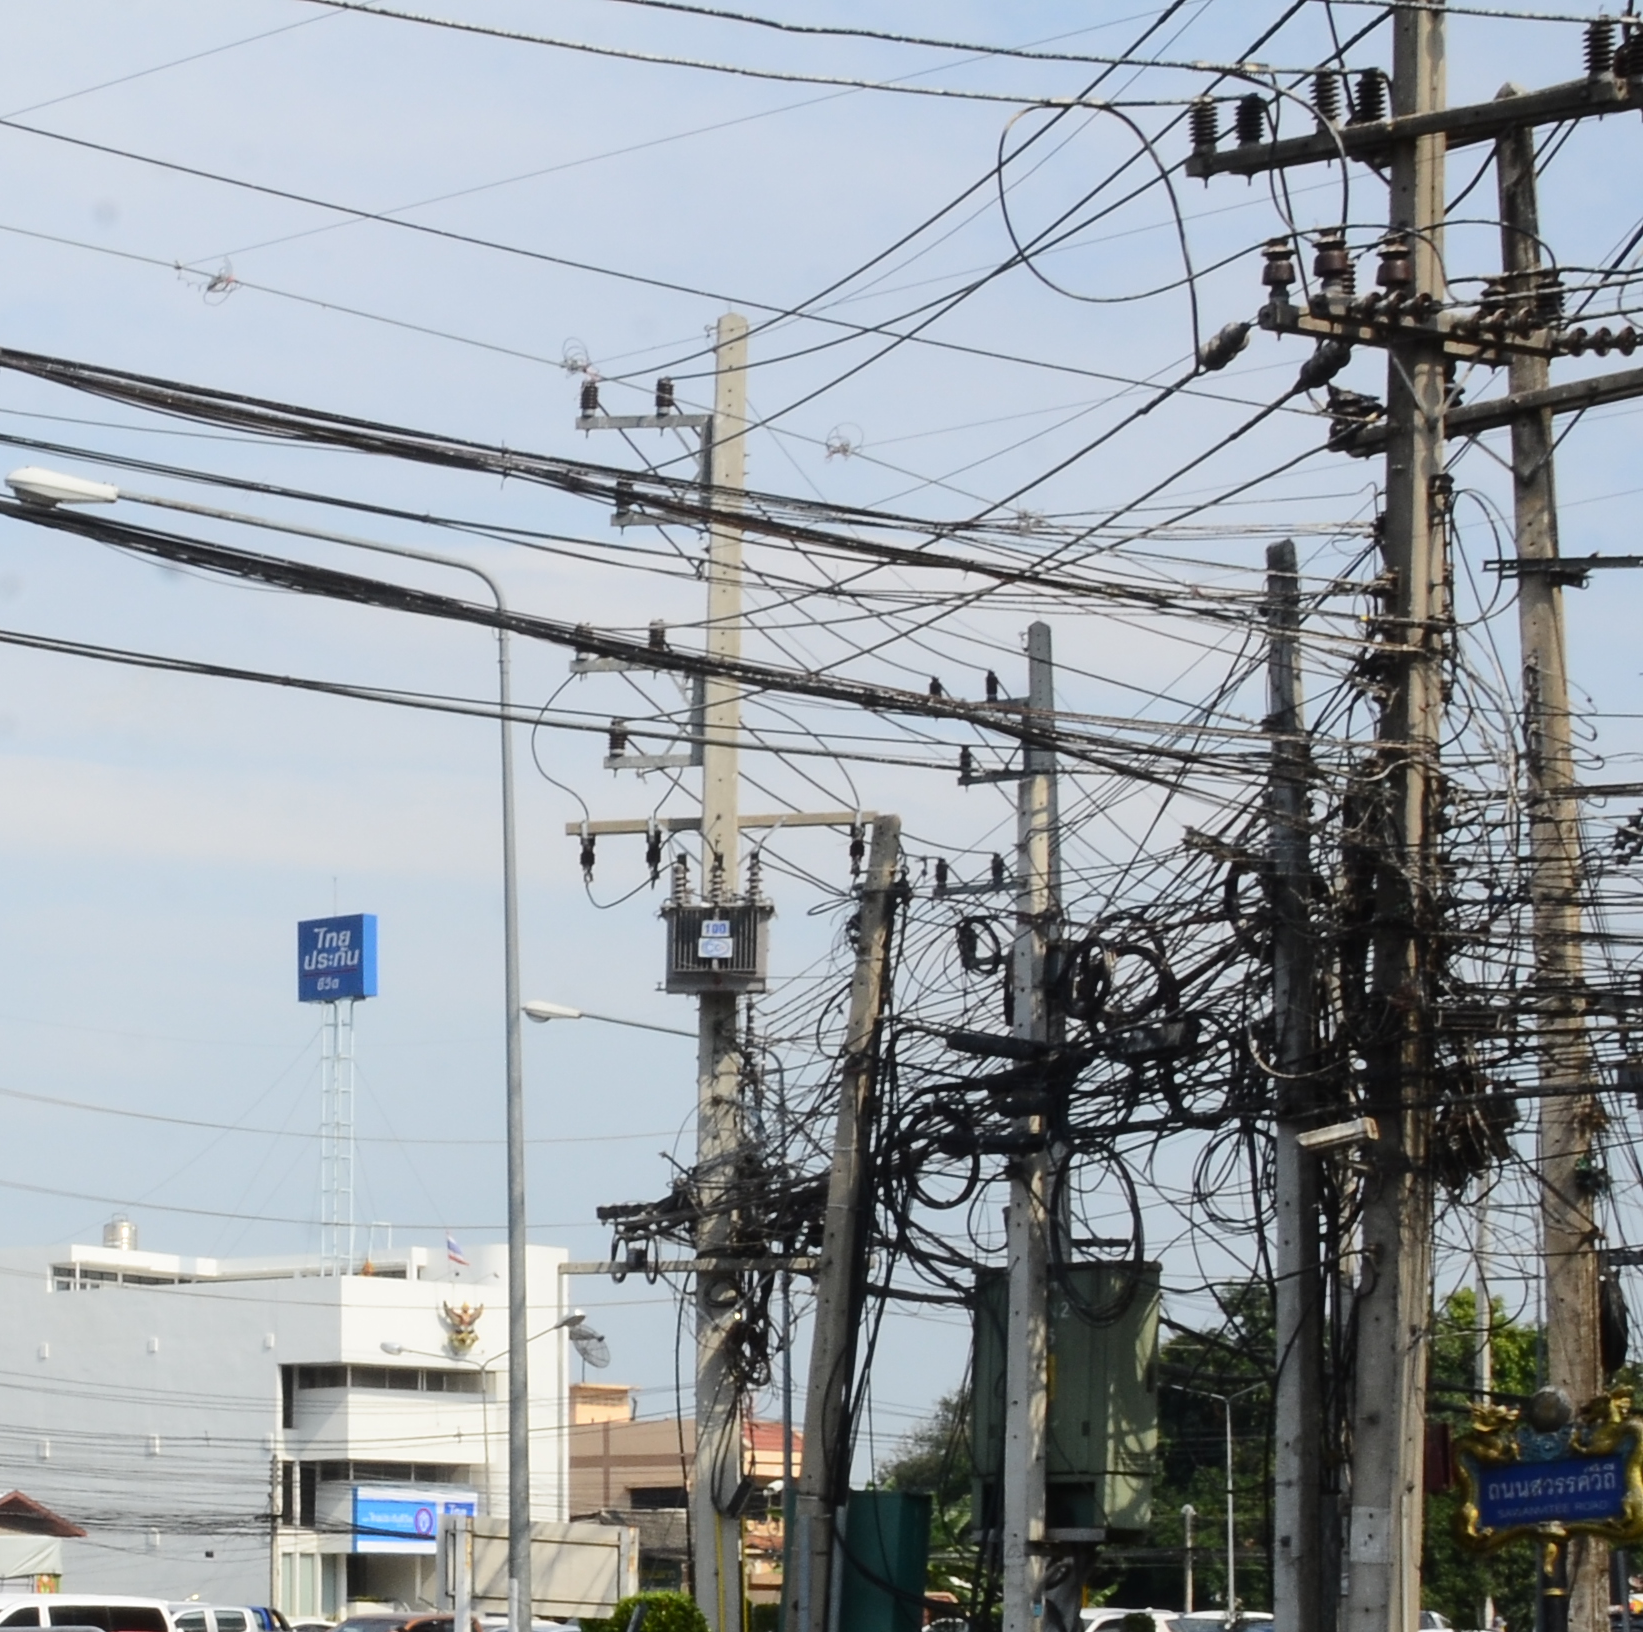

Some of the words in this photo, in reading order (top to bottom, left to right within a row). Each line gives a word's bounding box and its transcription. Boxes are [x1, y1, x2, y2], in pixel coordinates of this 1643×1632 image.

[313, 926, 351, 950] ไทย
[705, 922, 727, 935] 100
[303, 946, 360, 971] ประกัน
[1488, 1463, 1615, 1501] ถนนสวรรค์วิถี
[1574, 1499, 1609, 1513] ROAD
